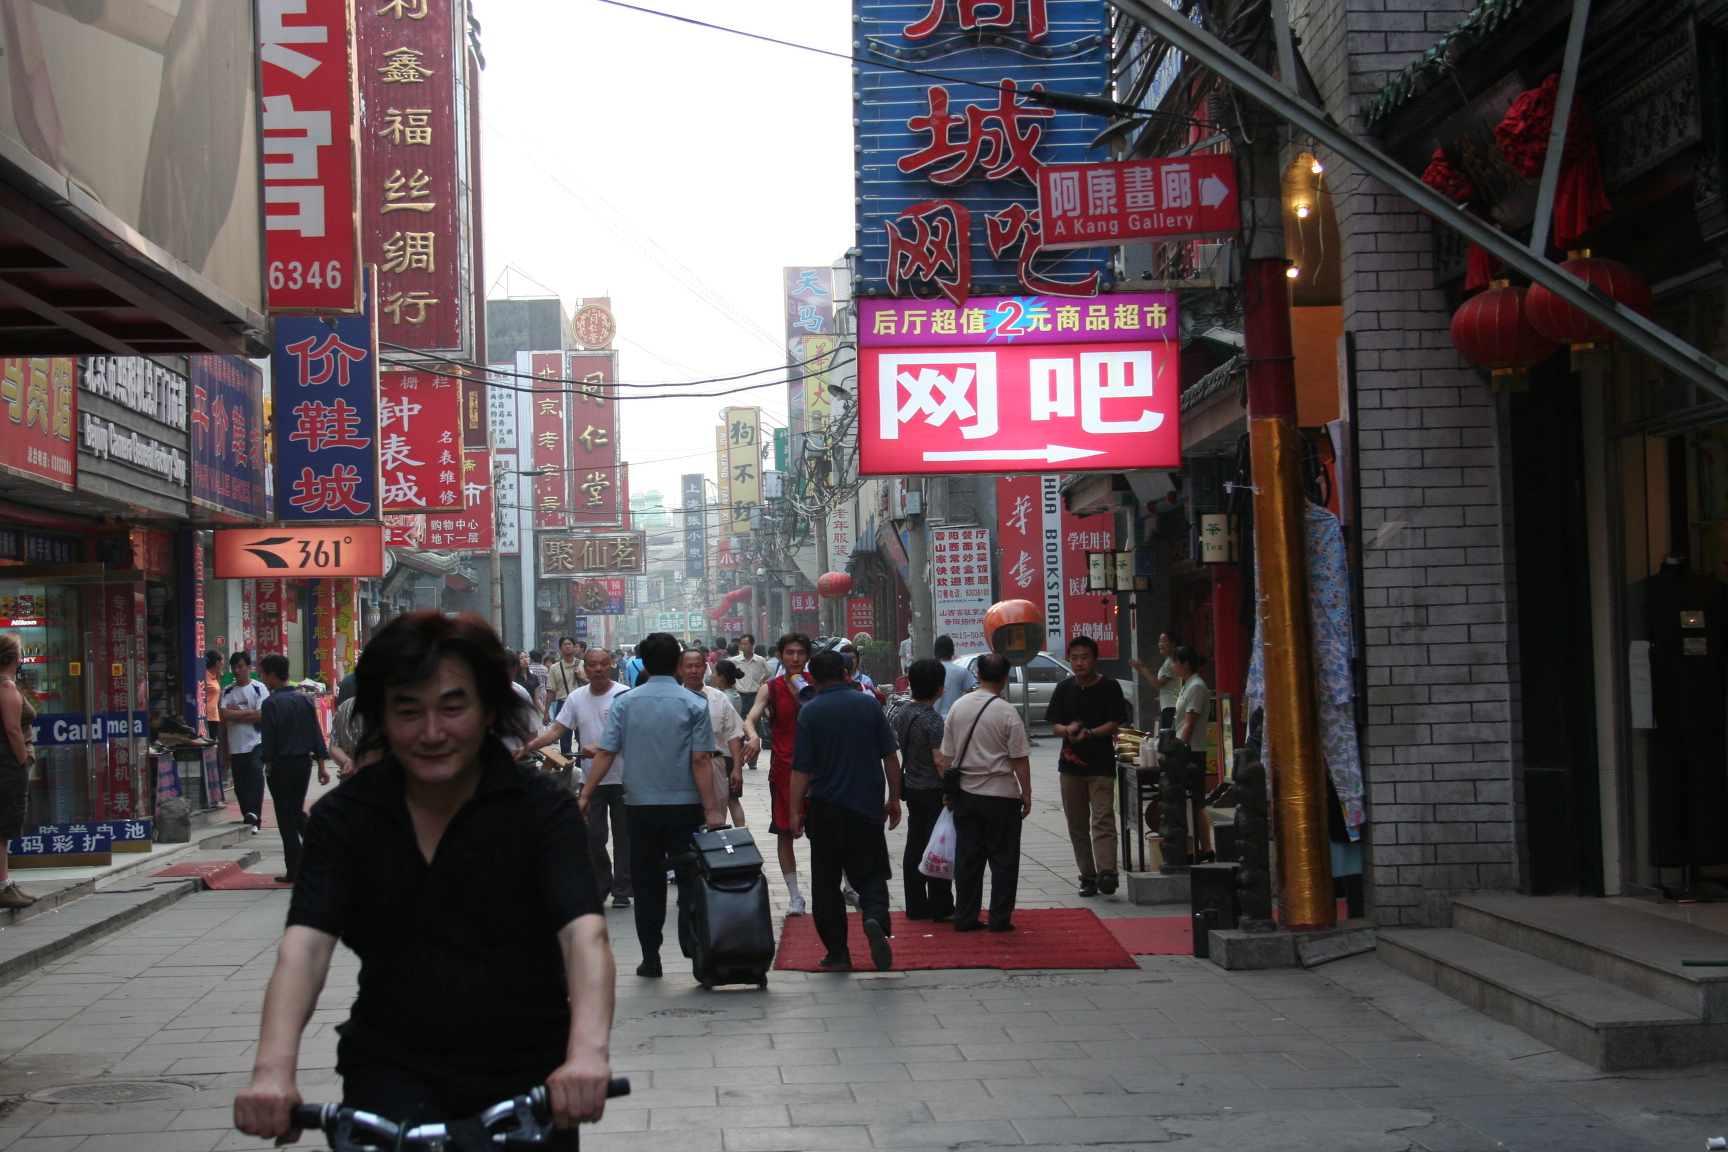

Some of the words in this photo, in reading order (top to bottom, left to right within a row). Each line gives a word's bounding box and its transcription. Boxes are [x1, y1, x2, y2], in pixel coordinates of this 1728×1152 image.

[1054, 219, 1067, 235] A
[1074, 217, 1119, 236] Kang
[1128, 212, 1194, 231] Gallery
[791, 270, 830, 333] 天马
[878, 350, 1165, 440] 网吧
[286, 317, 371, 515] 价鞋城
[379, 397, 427, 508] 钟表城
[537, 365, 562, 515] 北京老字号
[579, 370, 612, 508] 同仁堂
[438, 430, 458, 506] 名表维修
[431, 519, 479, 531] 购物中心
[431, 532, 479, 546] 地下一层
[832, 508, 850, 556] 老年服装
[1067, 531, 1111, 551] 学生用书
[935, 542, 987, 553] 山西面食
[1205, 542, 1224, 551] Tea
[1045, 530, 1062, 639] BOOKSTORE
[1069, 577, 1114, 596] 医药
[1117, 575, 1129, 583] Tea
[257, 579, 280, 659] 亨得利
[1071, 622, 1114, 641] 音像制品
[53, 718, 103, 742] Card
